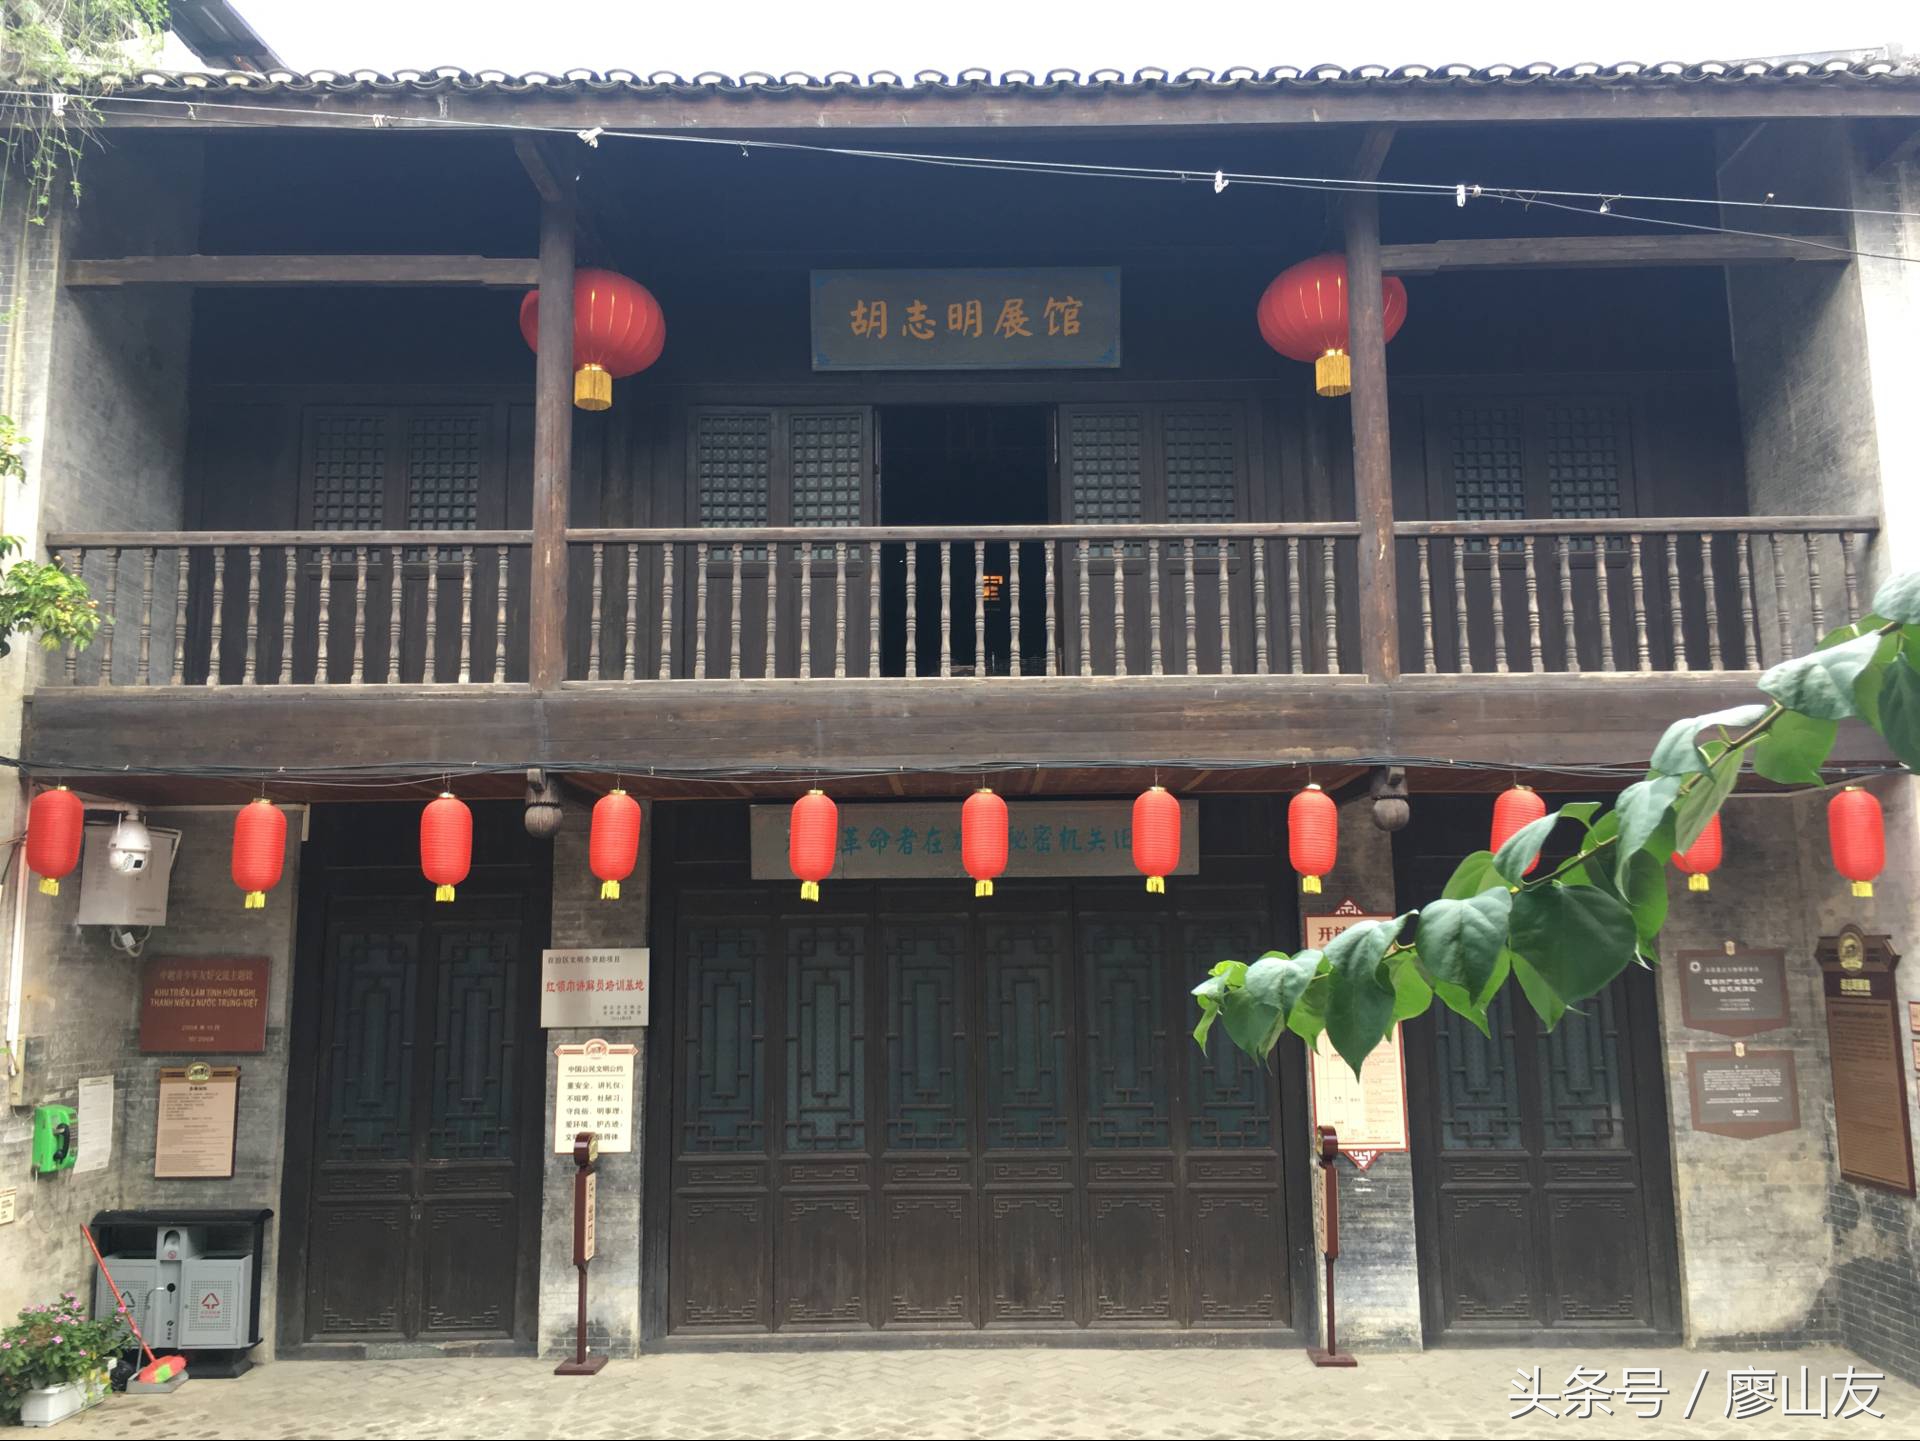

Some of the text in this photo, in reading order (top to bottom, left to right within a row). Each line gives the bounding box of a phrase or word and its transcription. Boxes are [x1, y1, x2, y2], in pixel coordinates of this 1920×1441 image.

[849, 296, 1083, 340] 胡志明展馆
[546, 979, 645, 993] 红领巾讲解员培训基地
